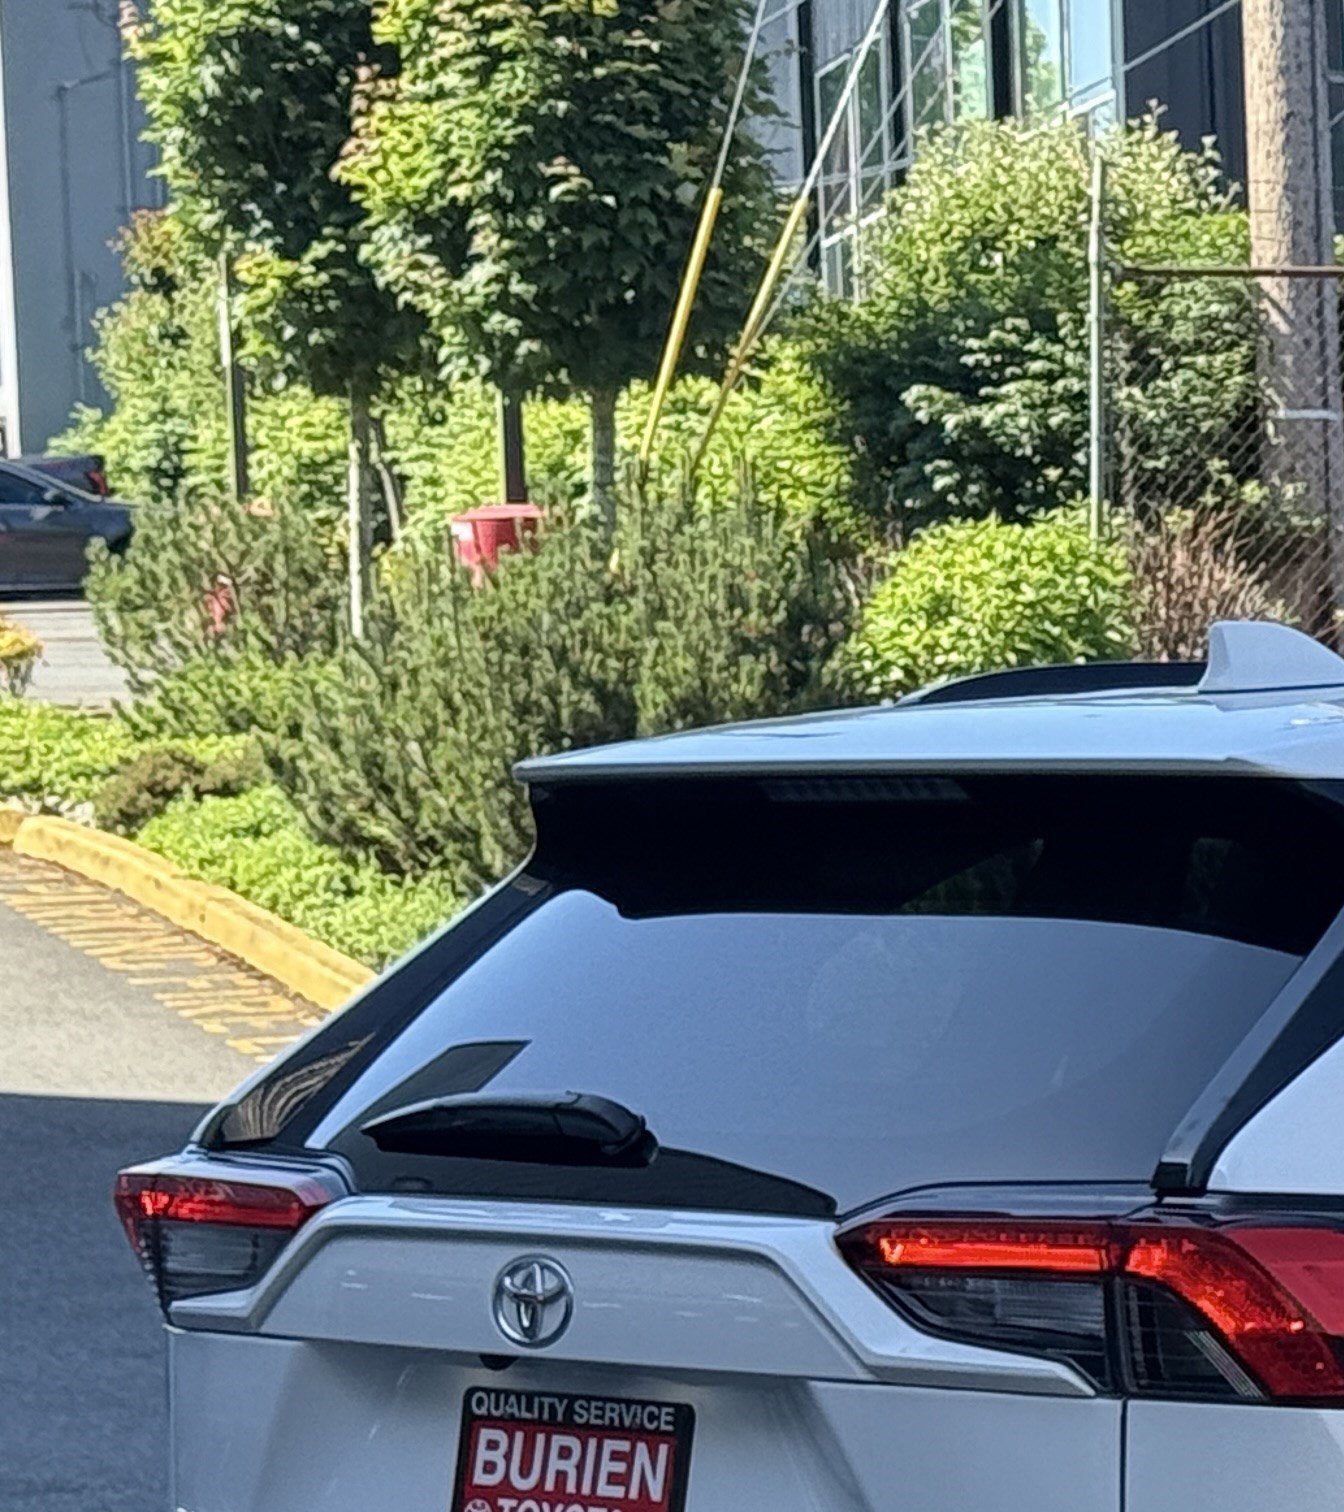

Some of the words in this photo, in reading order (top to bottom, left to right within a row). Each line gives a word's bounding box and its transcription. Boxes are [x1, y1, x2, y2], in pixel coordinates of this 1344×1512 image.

[471, 1391, 567, 1422] QUALITY
[573, 1400, 675, 1432] SERVICE
[472, 1427, 670, 1503] BURIEN
